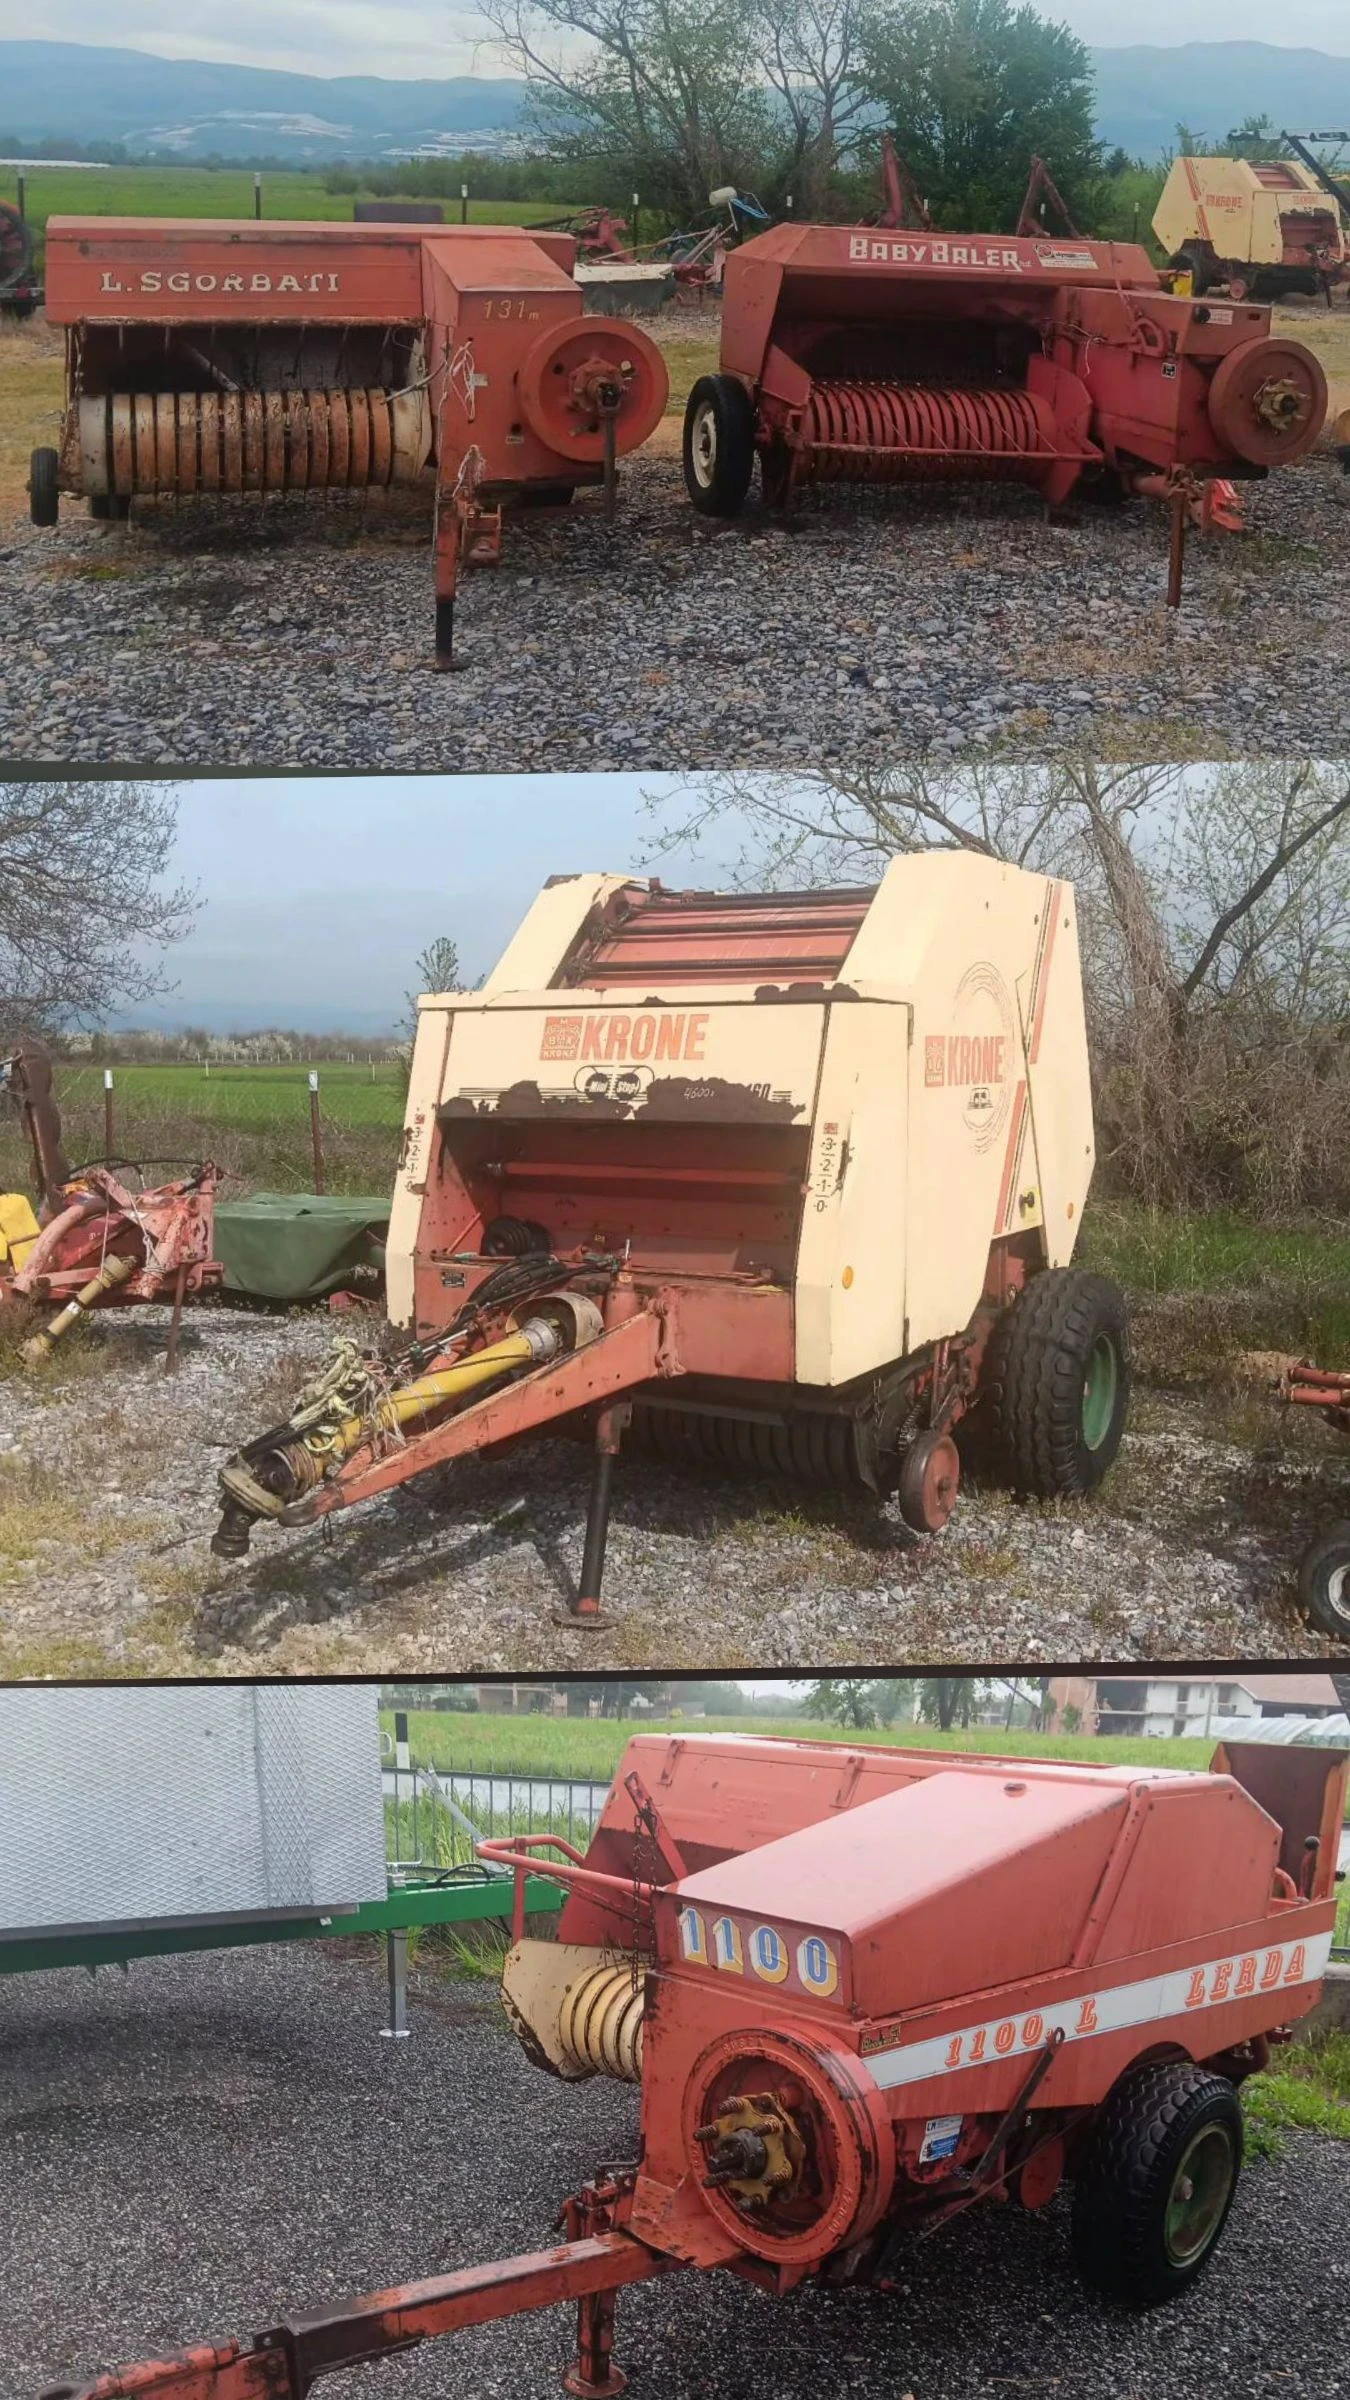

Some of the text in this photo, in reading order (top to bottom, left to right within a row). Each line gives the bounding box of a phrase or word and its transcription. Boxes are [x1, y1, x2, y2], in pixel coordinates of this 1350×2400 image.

[850, 237, 1023, 273] BABY BALER
[580, 1013, 709, 1061] KRONE
[947, 1036, 1005, 1086] KRONE
[679, 1907, 838, 1997] 1100
[1185, 1944, 1306, 2008] LERDA
[1076, 1998, 1099, 2034] L
